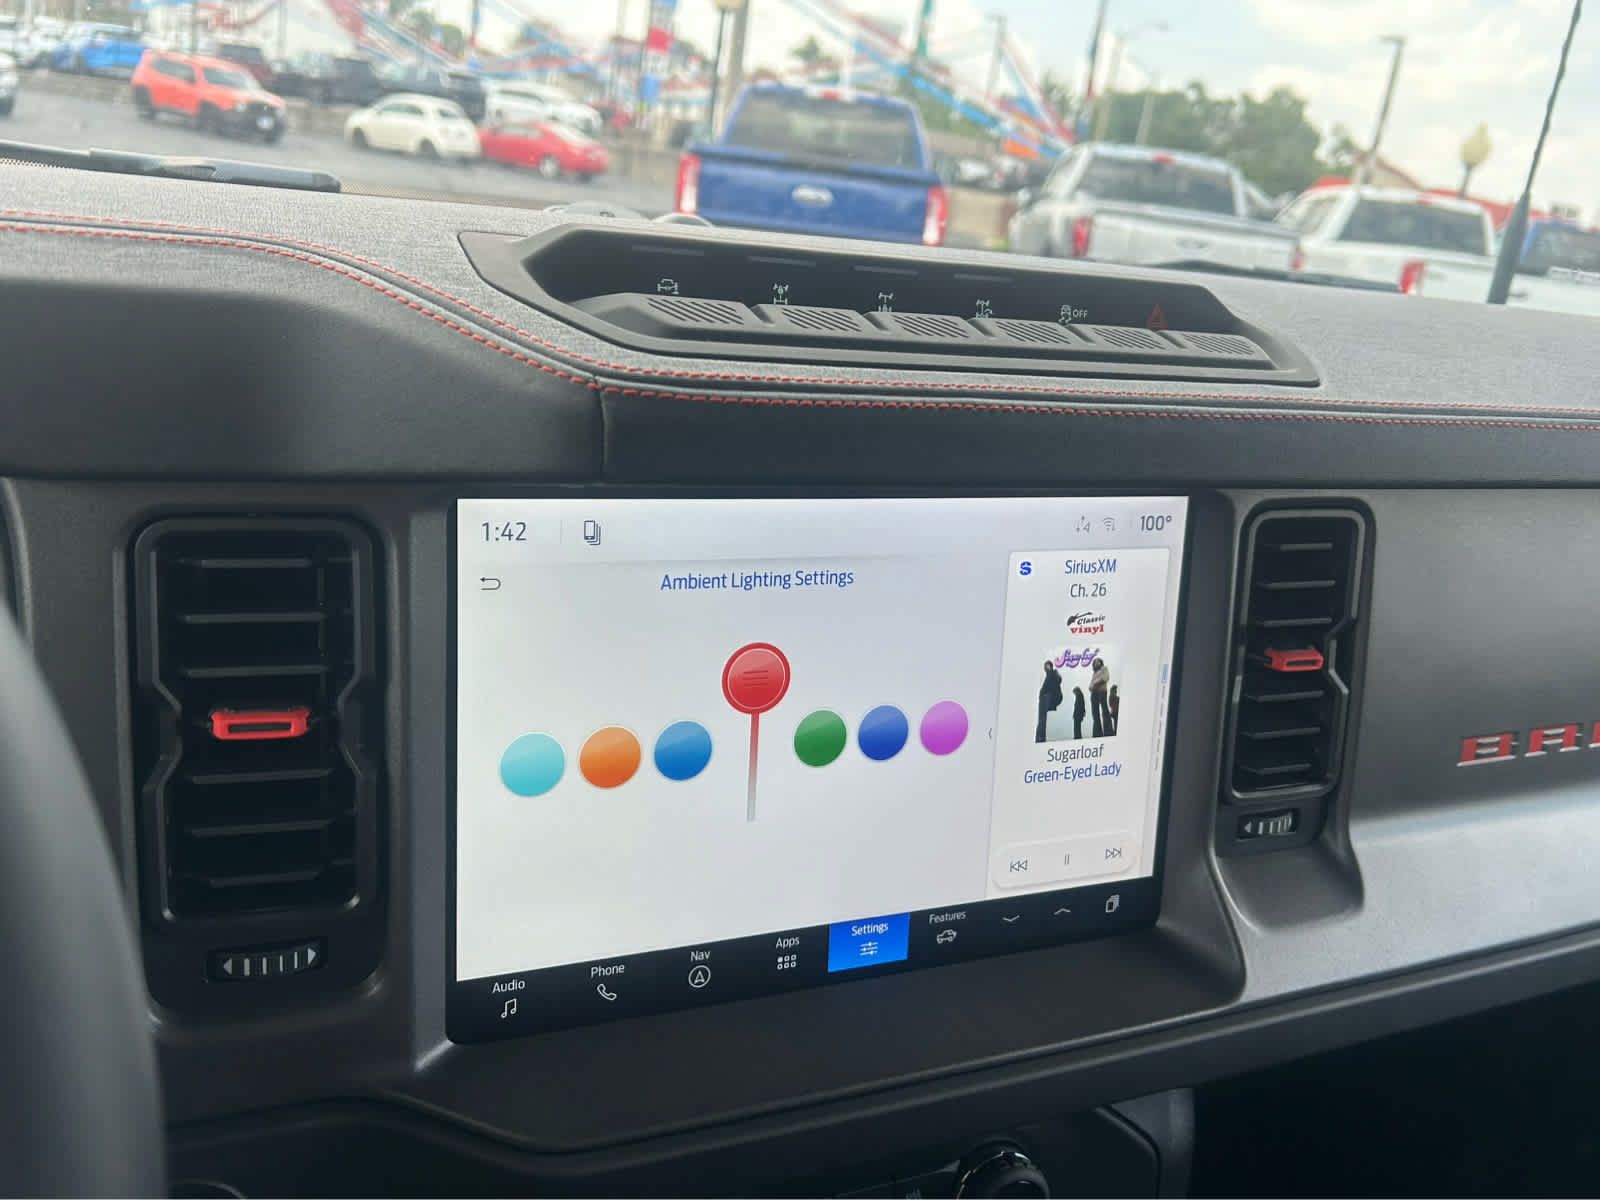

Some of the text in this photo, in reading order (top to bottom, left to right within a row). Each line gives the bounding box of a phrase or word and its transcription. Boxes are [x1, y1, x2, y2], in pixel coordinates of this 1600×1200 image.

[1072, 308, 1088, 319] OFF
[1140, 515, 1172, 531] 100°
[481, 522, 528, 542] 1:42
[1064, 559, 1117, 575] SiriusXM
[660, 569, 854, 591] Ambient Lighting Settings
[1070, 583, 1107, 598] Ch. 26
[1047, 744, 1104, 763] Sugarloaf
[1024, 762, 1122, 784] Green-Eyed Lady
[929, 911, 967, 924] Features
[851, 922, 889, 937] Settings
[775, 936, 800, 951] Apps
[690, 951, 711, 961] Nav
[590, 963, 625, 978] Phone
[492, 979, 526, 993] Audio
